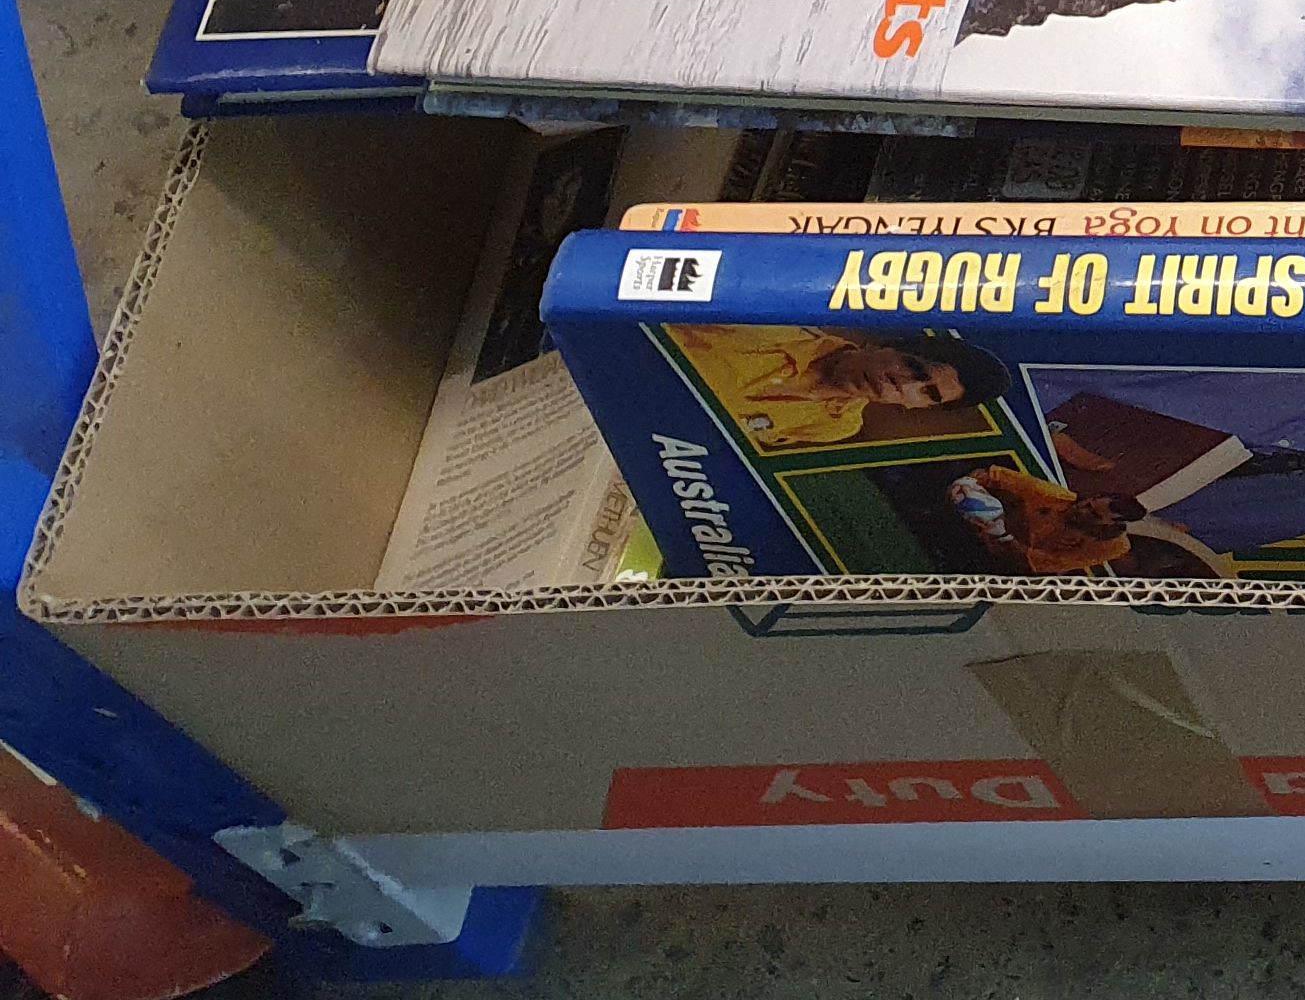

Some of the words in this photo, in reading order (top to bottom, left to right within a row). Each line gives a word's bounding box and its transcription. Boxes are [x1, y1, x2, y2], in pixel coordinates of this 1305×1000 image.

[1083, 207, 1188, 236] Yoga
[1201, 215, 1252, 235] on
[631, 255, 652, 292] Sports
[646, 254, 664, 293] Harper
[760, 769, 1061, 809] Duty
